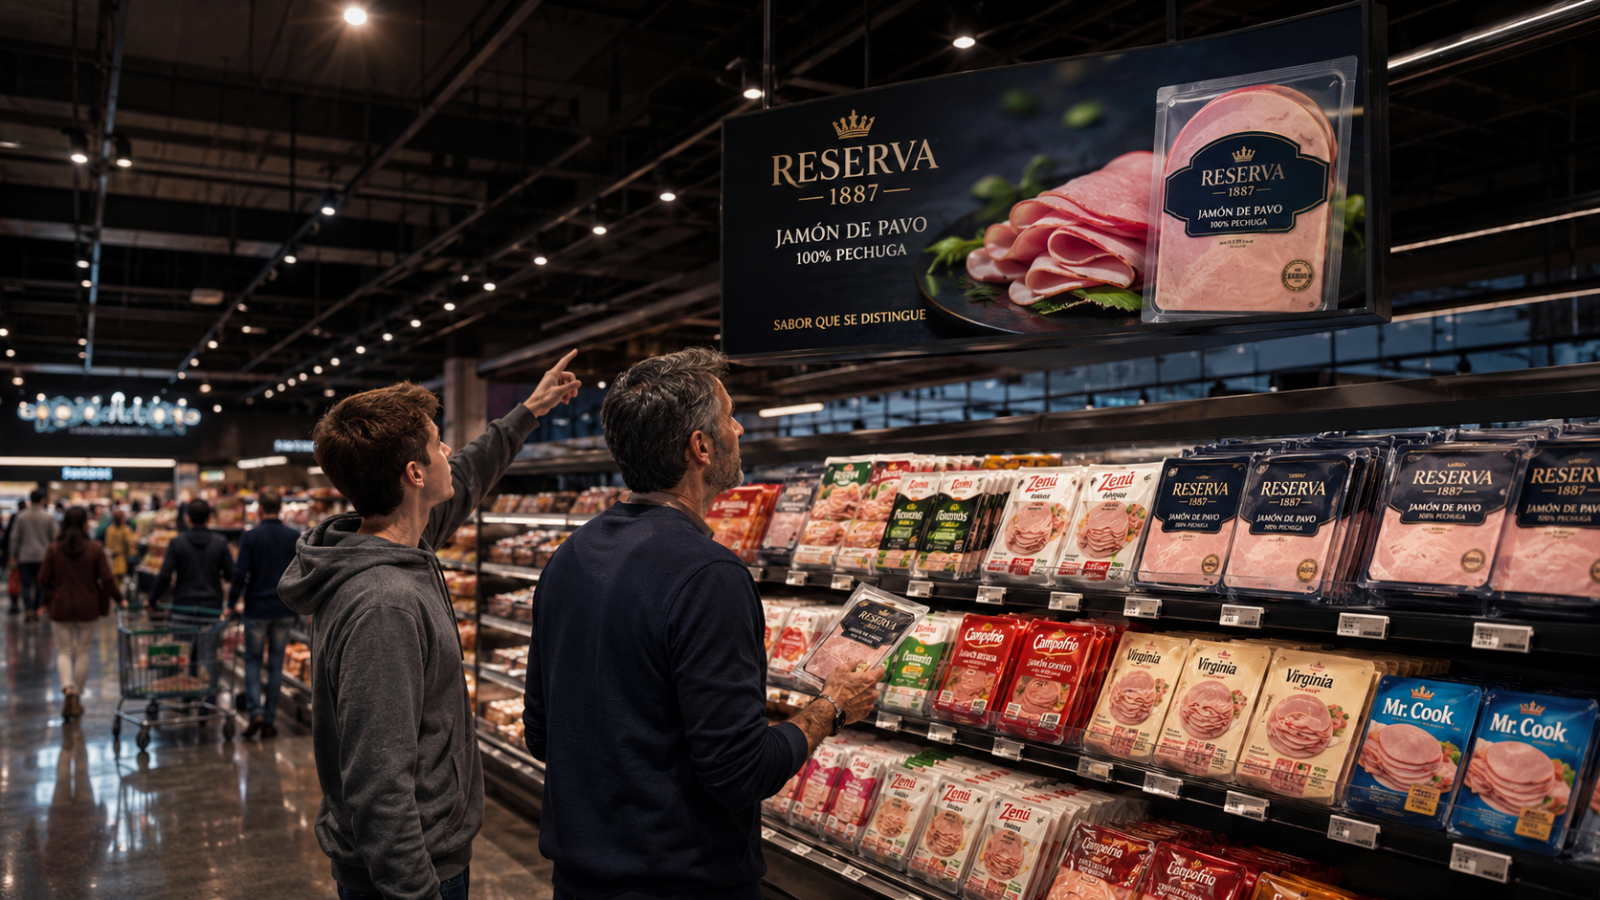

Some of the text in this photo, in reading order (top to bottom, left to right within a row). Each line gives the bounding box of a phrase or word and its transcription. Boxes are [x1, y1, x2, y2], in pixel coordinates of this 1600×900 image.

[771, 139, 939, 188] RESERVA
[1201, 163, 1286, 187] RESERVA
[830, 183, 879, 206] 1887
[1228, 185, 1255, 197] 1887
[1197, 204, 1283, 221] JAMÓN DE PAVO
[1210, 218, 1268, 229] 100% PECHUGA
[775, 216, 927, 249] JAMÓN DE PAVO
[796, 243, 907, 265] 100% PECHUGA
[773, 309, 926, 331] SABOR QUE SE DISTINGUE
[1025, 473, 1059, 493] Zenú
[1097, 471, 1135, 492] Zenú
[1412, 470, 1493, 485] RESERVA
[1172, 482, 1229, 497] RESERVA
[1260, 481, 1326, 497] RESERVA
[1437, 487, 1463, 496] 1887
[1557, 485, 1587, 496] 1887
[1189, 497, 1208, 506] 1887
[1280, 497, 1301, 507] 1887
[1408, 502, 1482, 512] JAMÓN DE PAVO
[1526, 502, 1600, 514] JAMÓN DE PAV
[1168, 512, 1191, 521] JAMÓN
[1191, 513, 1201, 521] DE
[1256, 513, 1317, 523] JAMÓN DE PAVO
[1127, 648, 1161, 665] Virginia
[1198, 657, 1237, 675] Virginia
[1285, 668, 1334, 689] Virginia
[1382, 698, 1408, 717] Mr.
[1489, 713, 1517, 735] Mr.
[943, 784, 972, 803] Zenú
[999, 803, 1032, 823] Zenú
